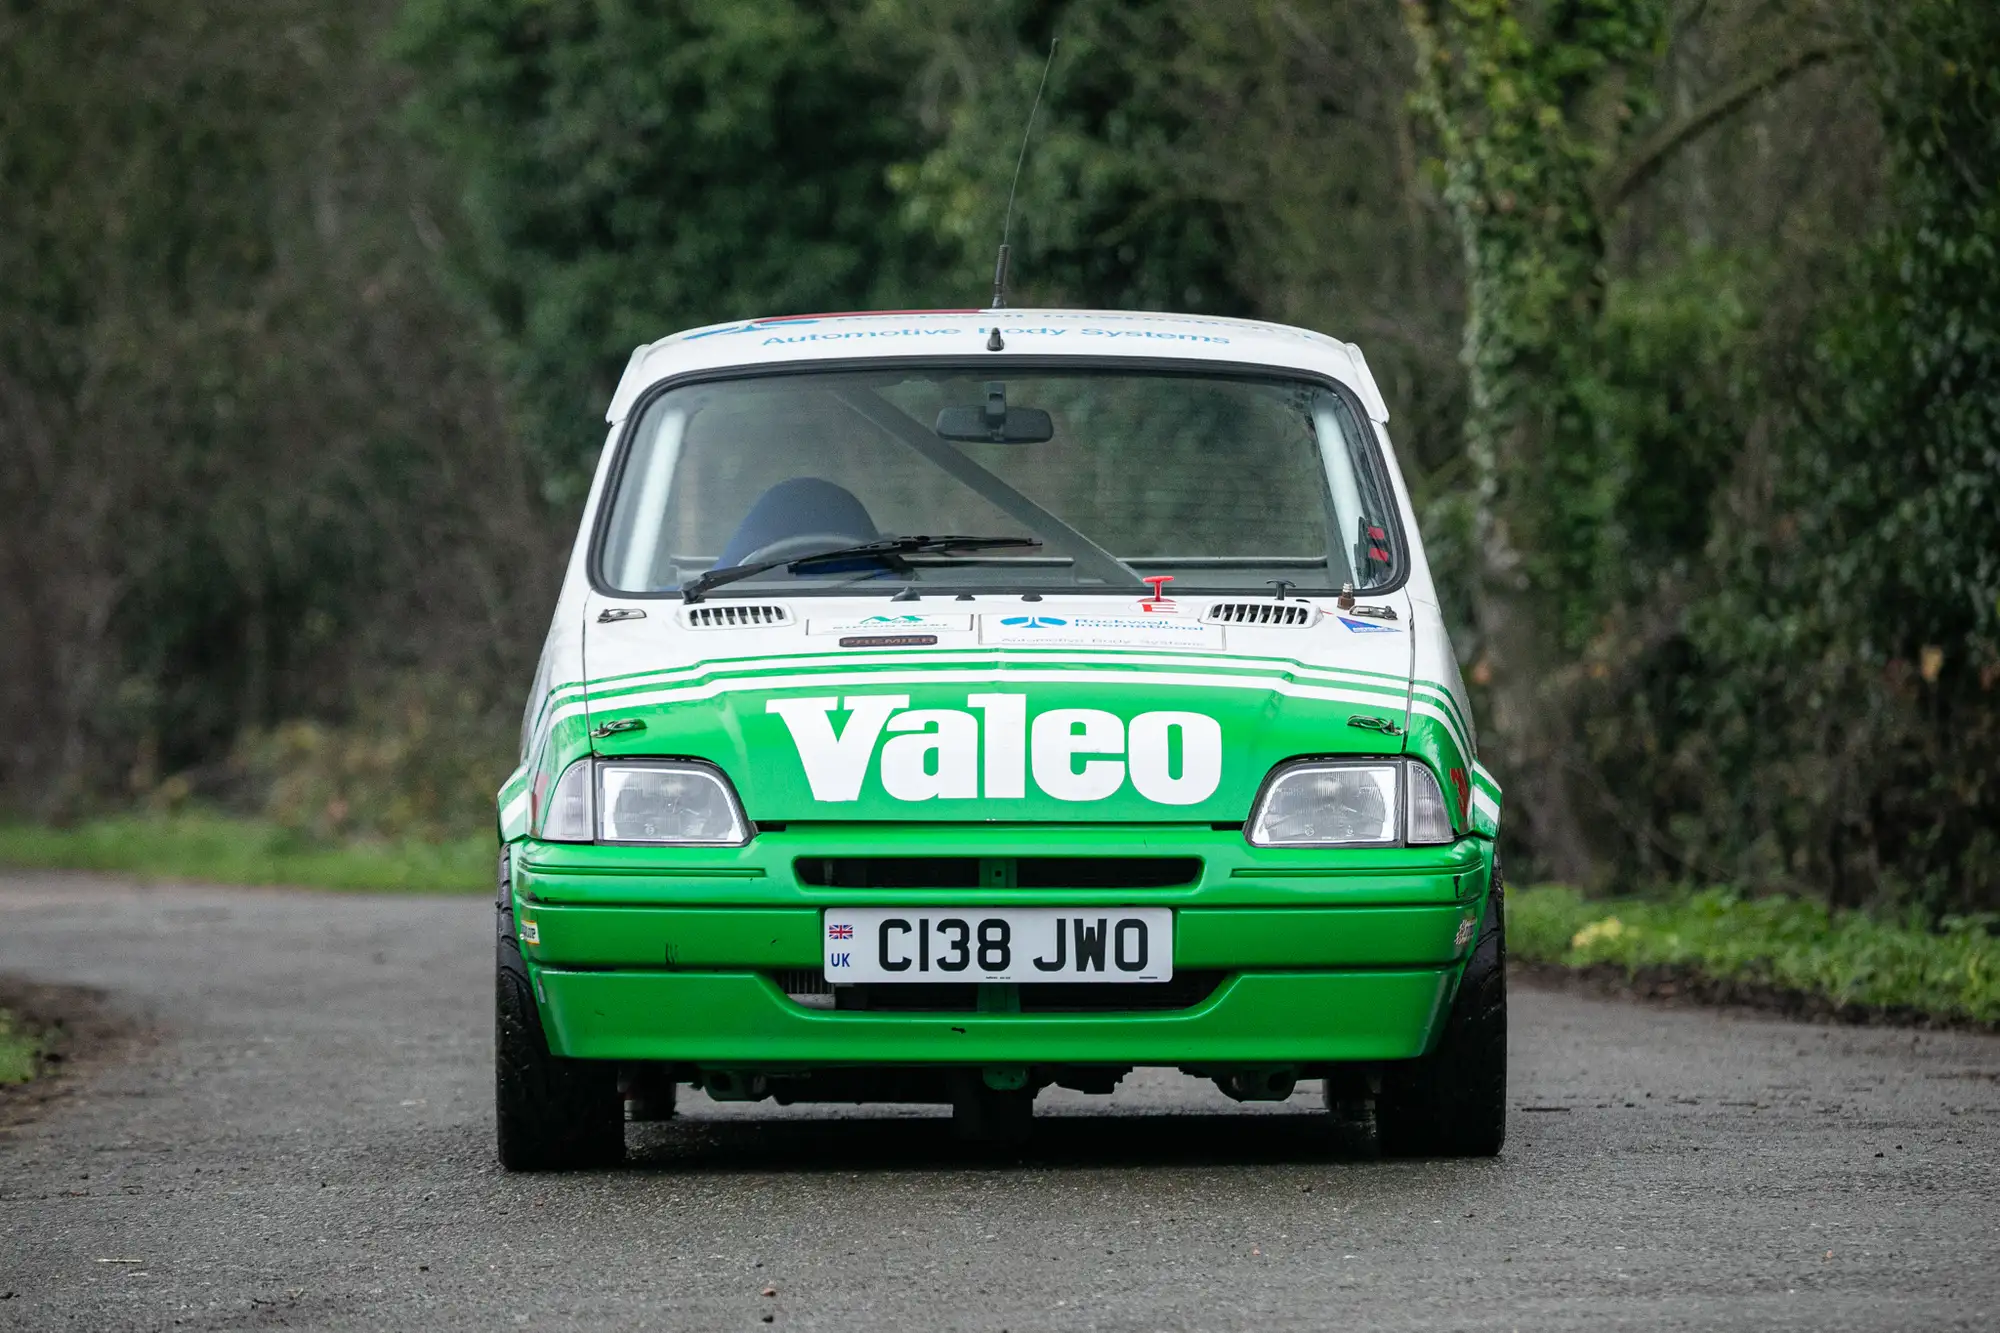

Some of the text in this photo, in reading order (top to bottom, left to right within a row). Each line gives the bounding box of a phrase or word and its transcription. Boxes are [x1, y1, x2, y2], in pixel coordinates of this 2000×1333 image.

[762, 327, 962, 346] Automotive
[1081, 328, 1230, 344] Systems
[1075, 623, 1204, 631] International
[765, 693, 1222, 805] Valeo
[878, 918, 1149, 972] C138 JWO
[830, 952, 851, 968] UK
